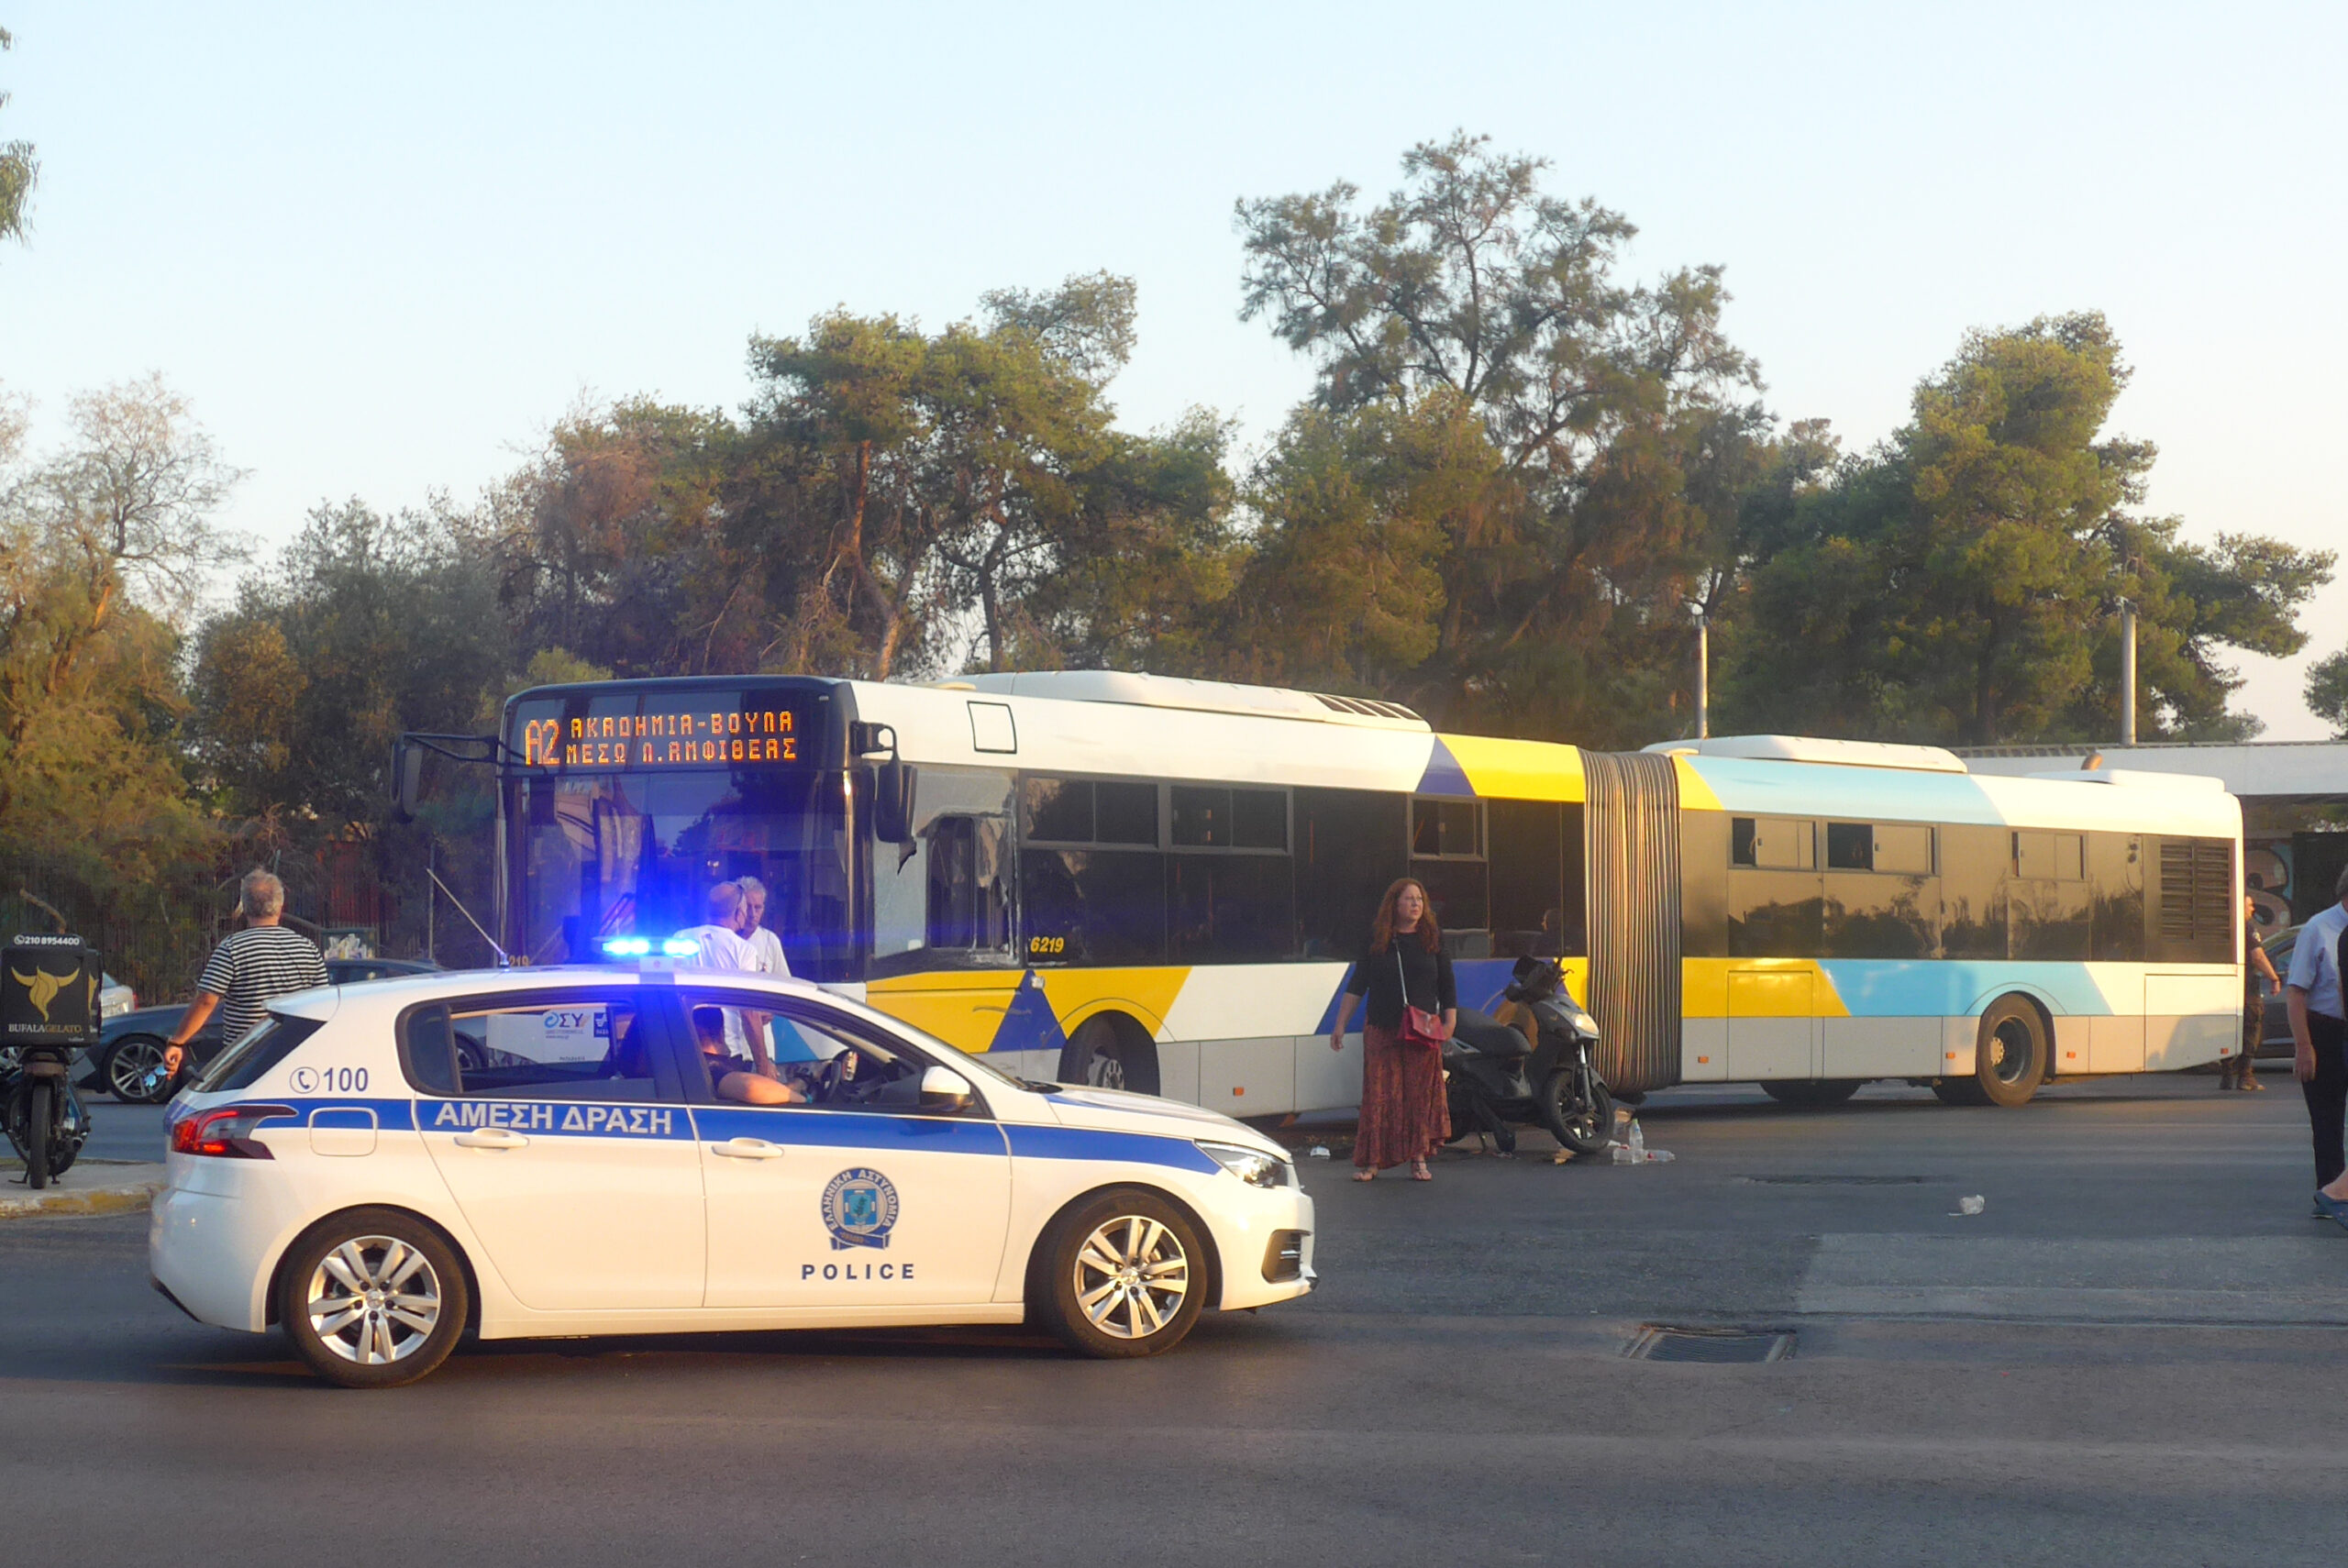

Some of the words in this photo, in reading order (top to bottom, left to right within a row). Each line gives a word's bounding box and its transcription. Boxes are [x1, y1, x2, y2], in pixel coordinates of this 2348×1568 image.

[525, 719, 559, 766] Α2
[566, 742, 627, 764] ΜΕΣΩ
[25, 935, 40, 944] 210
[41, 936, 81, 946] 8954400
[1030, 936, 1064, 954] 6219
[505, 955, 529, 967] 219
[323, 1066, 369, 1092] 100
[434, 1102, 553, 1130] ΑΜΕΣΗ
[560, 1106, 671, 1135] ΔΡΑΣΗ
[823, 1170, 853, 1231] ΕΛΛΗΝΙΚΗ
[858, 1168, 898, 1228] ΑΣΤΥΝΟΜΙΑ
[801, 1263, 914, 1281] POLICE
